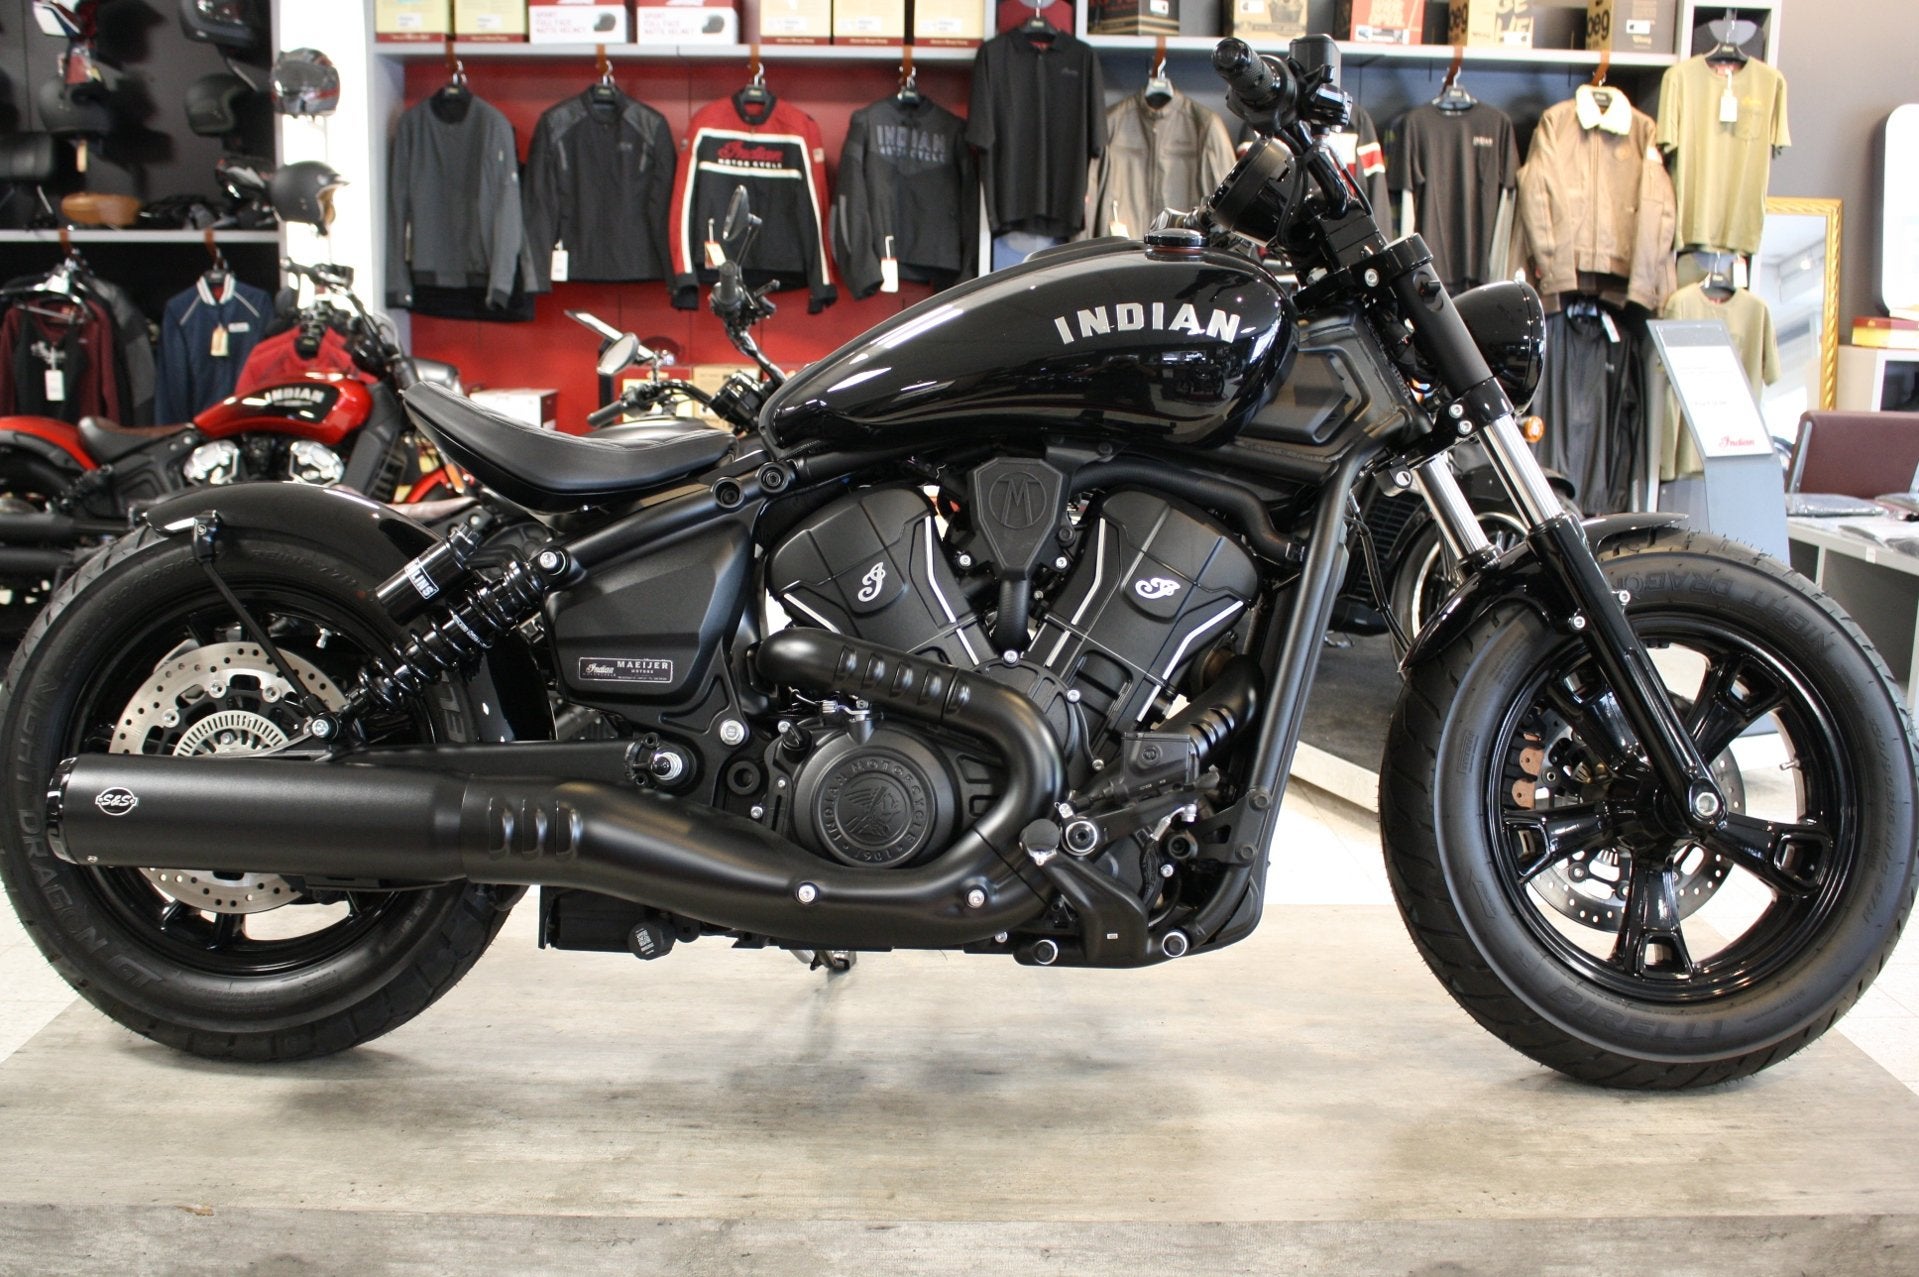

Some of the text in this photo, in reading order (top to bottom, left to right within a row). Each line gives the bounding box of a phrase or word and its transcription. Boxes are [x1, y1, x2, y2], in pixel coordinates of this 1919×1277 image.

[877, 125, 945, 152] INDIAN
[1054, 302, 1240, 345] INDIAN
[264, 387, 324, 403] INDIAN
[1720, 436, 1755, 448] Indian
[406, 561, 435, 597] LINS
[586, 663, 615, 674] Indian
[617, 660, 669, 670] MAEIJER
[101, 793, 132, 806] S&S
[1550, 985, 1728, 1040] PIRELLI
